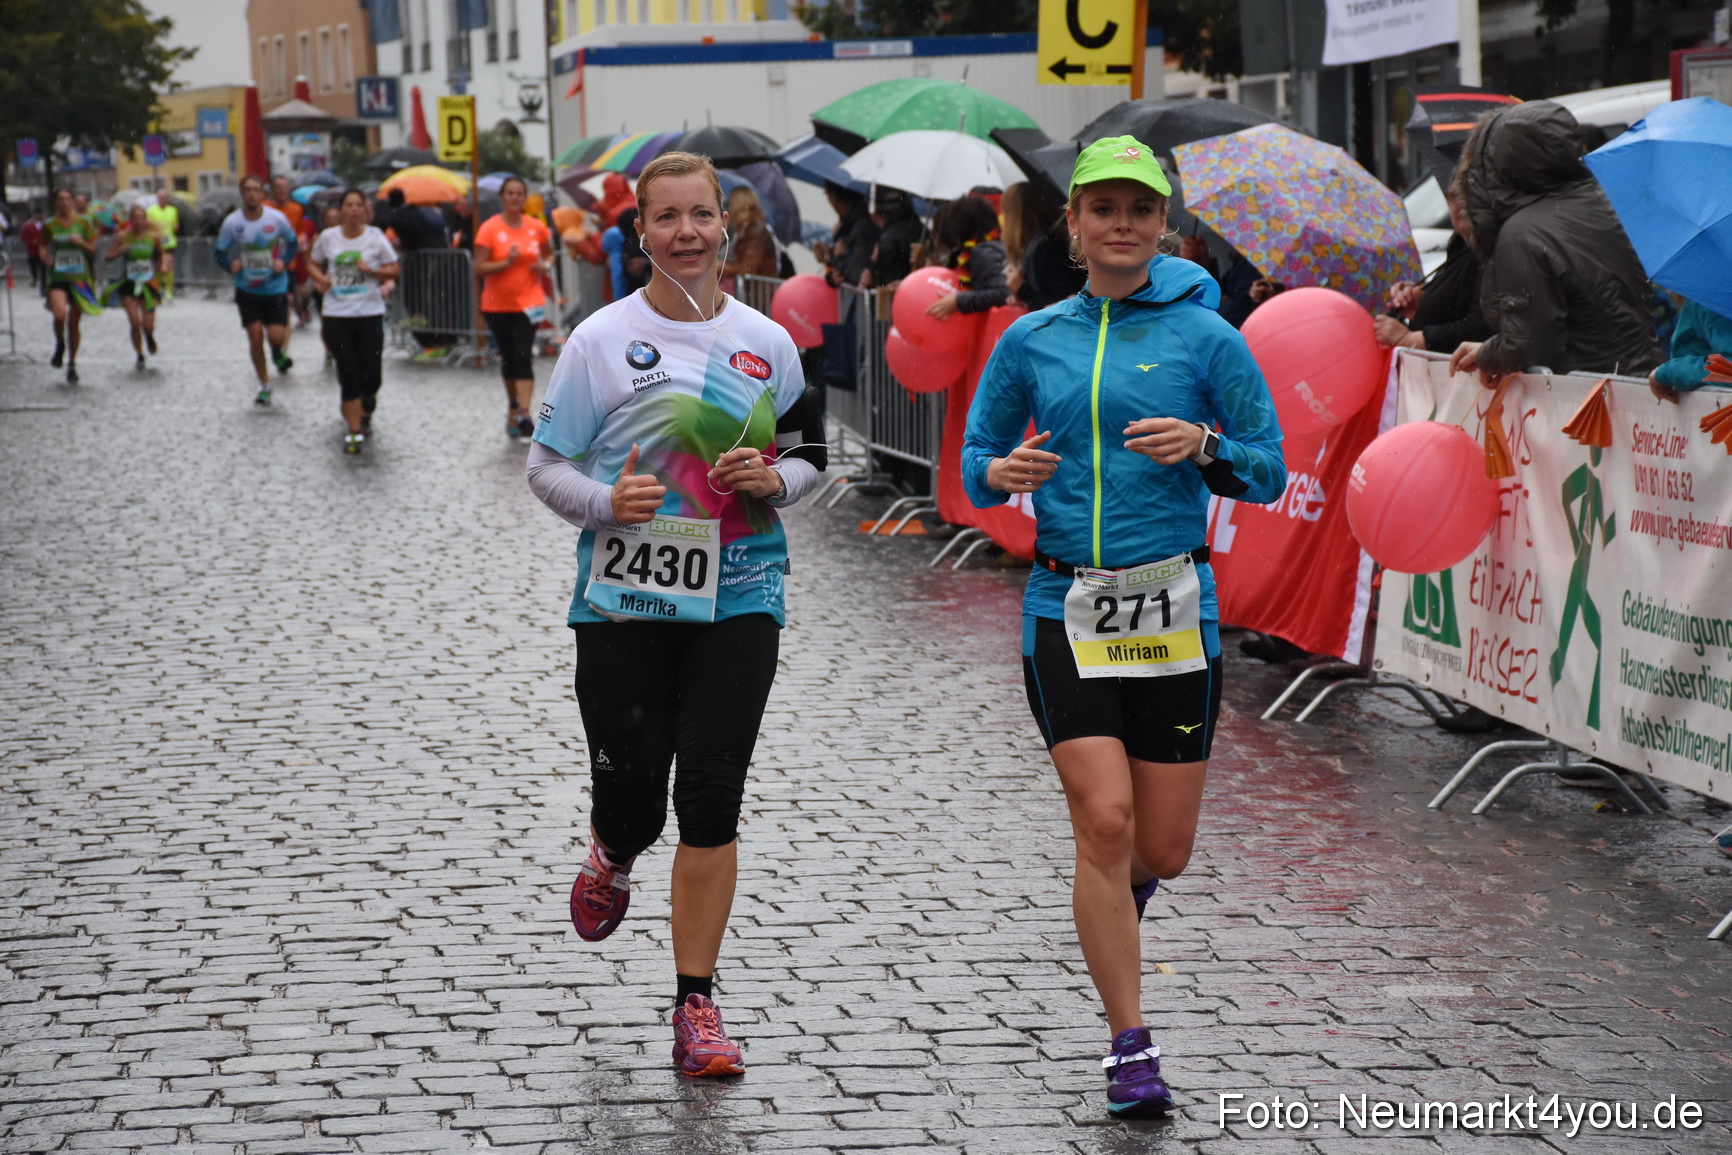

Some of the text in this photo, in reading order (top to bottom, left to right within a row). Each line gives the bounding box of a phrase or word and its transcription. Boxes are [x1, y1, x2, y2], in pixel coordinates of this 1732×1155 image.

[447, 115, 467, 146] D
[632, 371, 670, 387] PARTL
[634, 377, 672, 393] Neumarkt
[1631, 422, 1689, 460] Service-Line:
[1667, 469, 1679, 501] 63
[1681, 471, 1695, 502] 52
[649, 517, 711, 539] BOCK
[604, 536, 708, 591] 2430
[726, 545, 748, 562] 17.
[1081, 580, 1119, 591] NeuerMarkt
[1126, 560, 1184, 586] BOCK
[620, 593, 677, 617] Marika
[1094, 589, 1171, 634] 271
[1107, 643, 1169, 662] Miriam
[1621, 706, 1732, 773] Arbeitsbühnenverl
